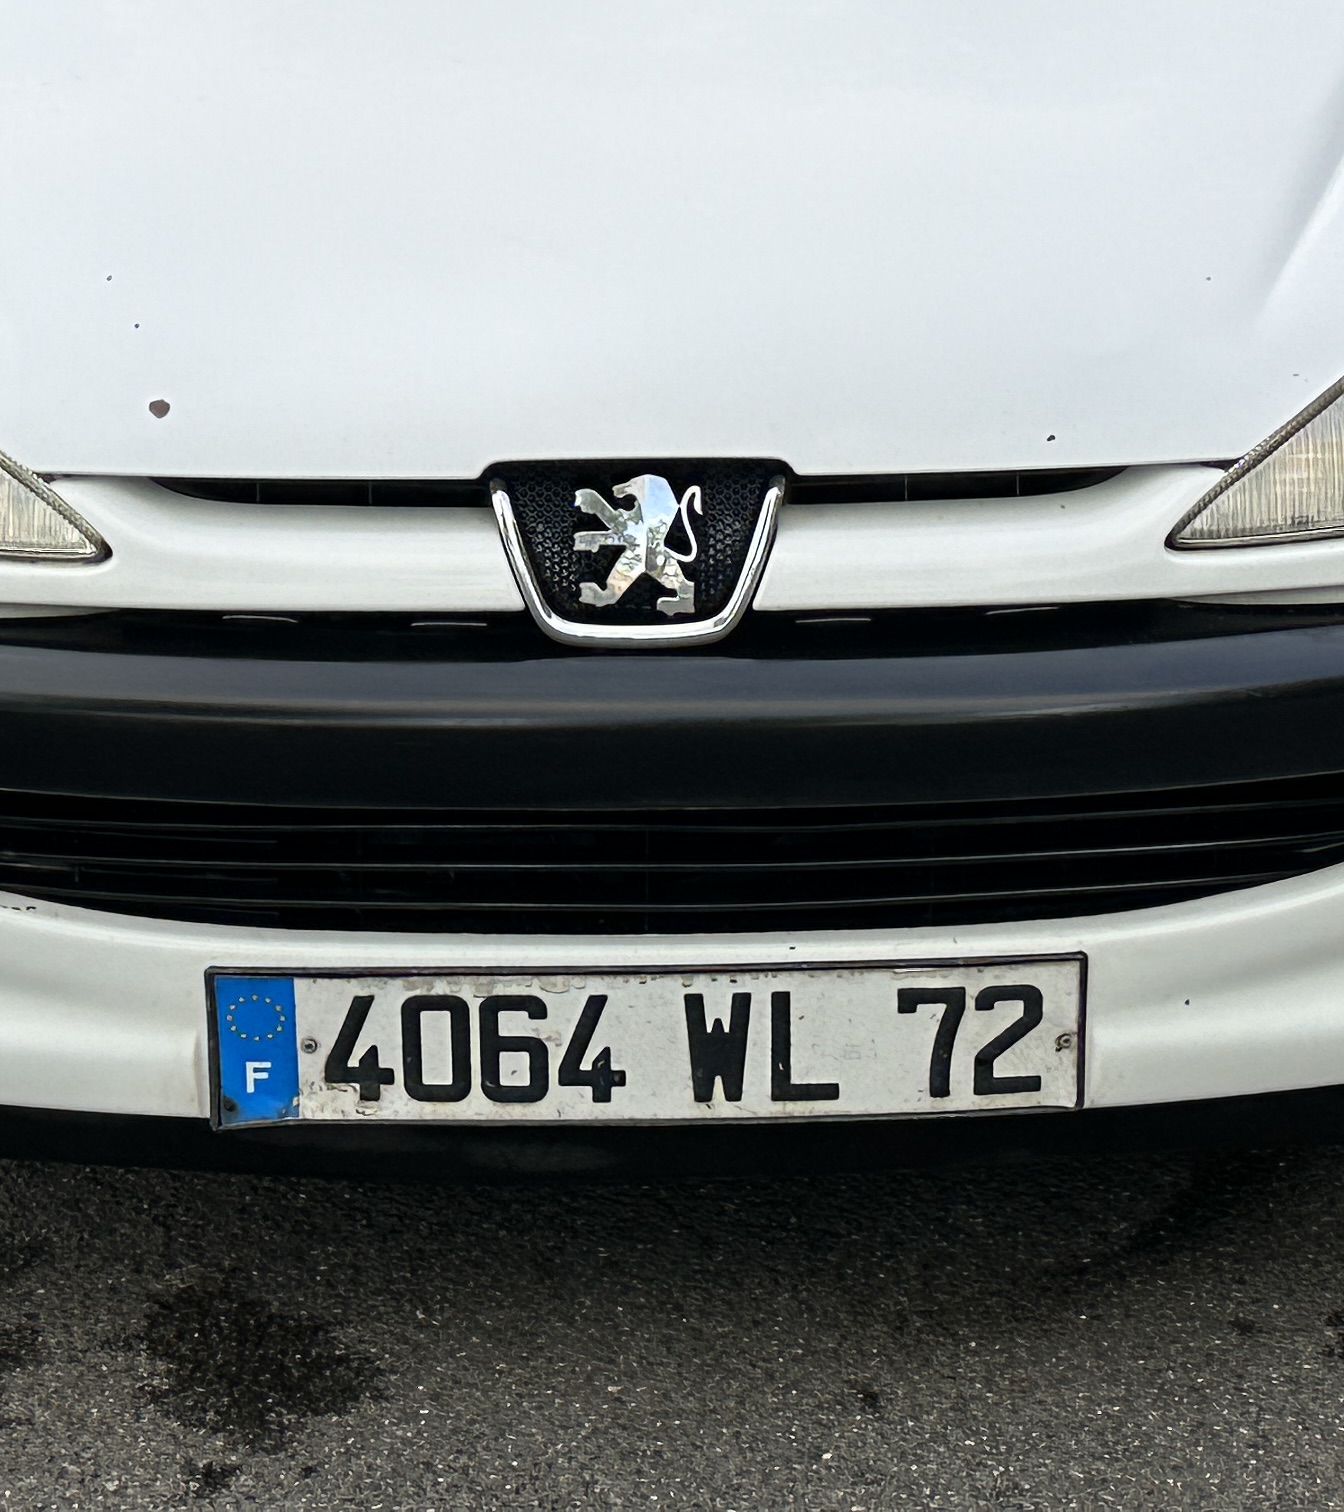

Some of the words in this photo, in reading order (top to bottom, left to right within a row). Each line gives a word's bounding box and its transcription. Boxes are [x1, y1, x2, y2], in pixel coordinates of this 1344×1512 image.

[245, 1061, 272, 1093] F
[323, 994, 627, 1104] 4064
[683, 991, 840, 1104] WL
[897, 985, 1044, 1099] 72
